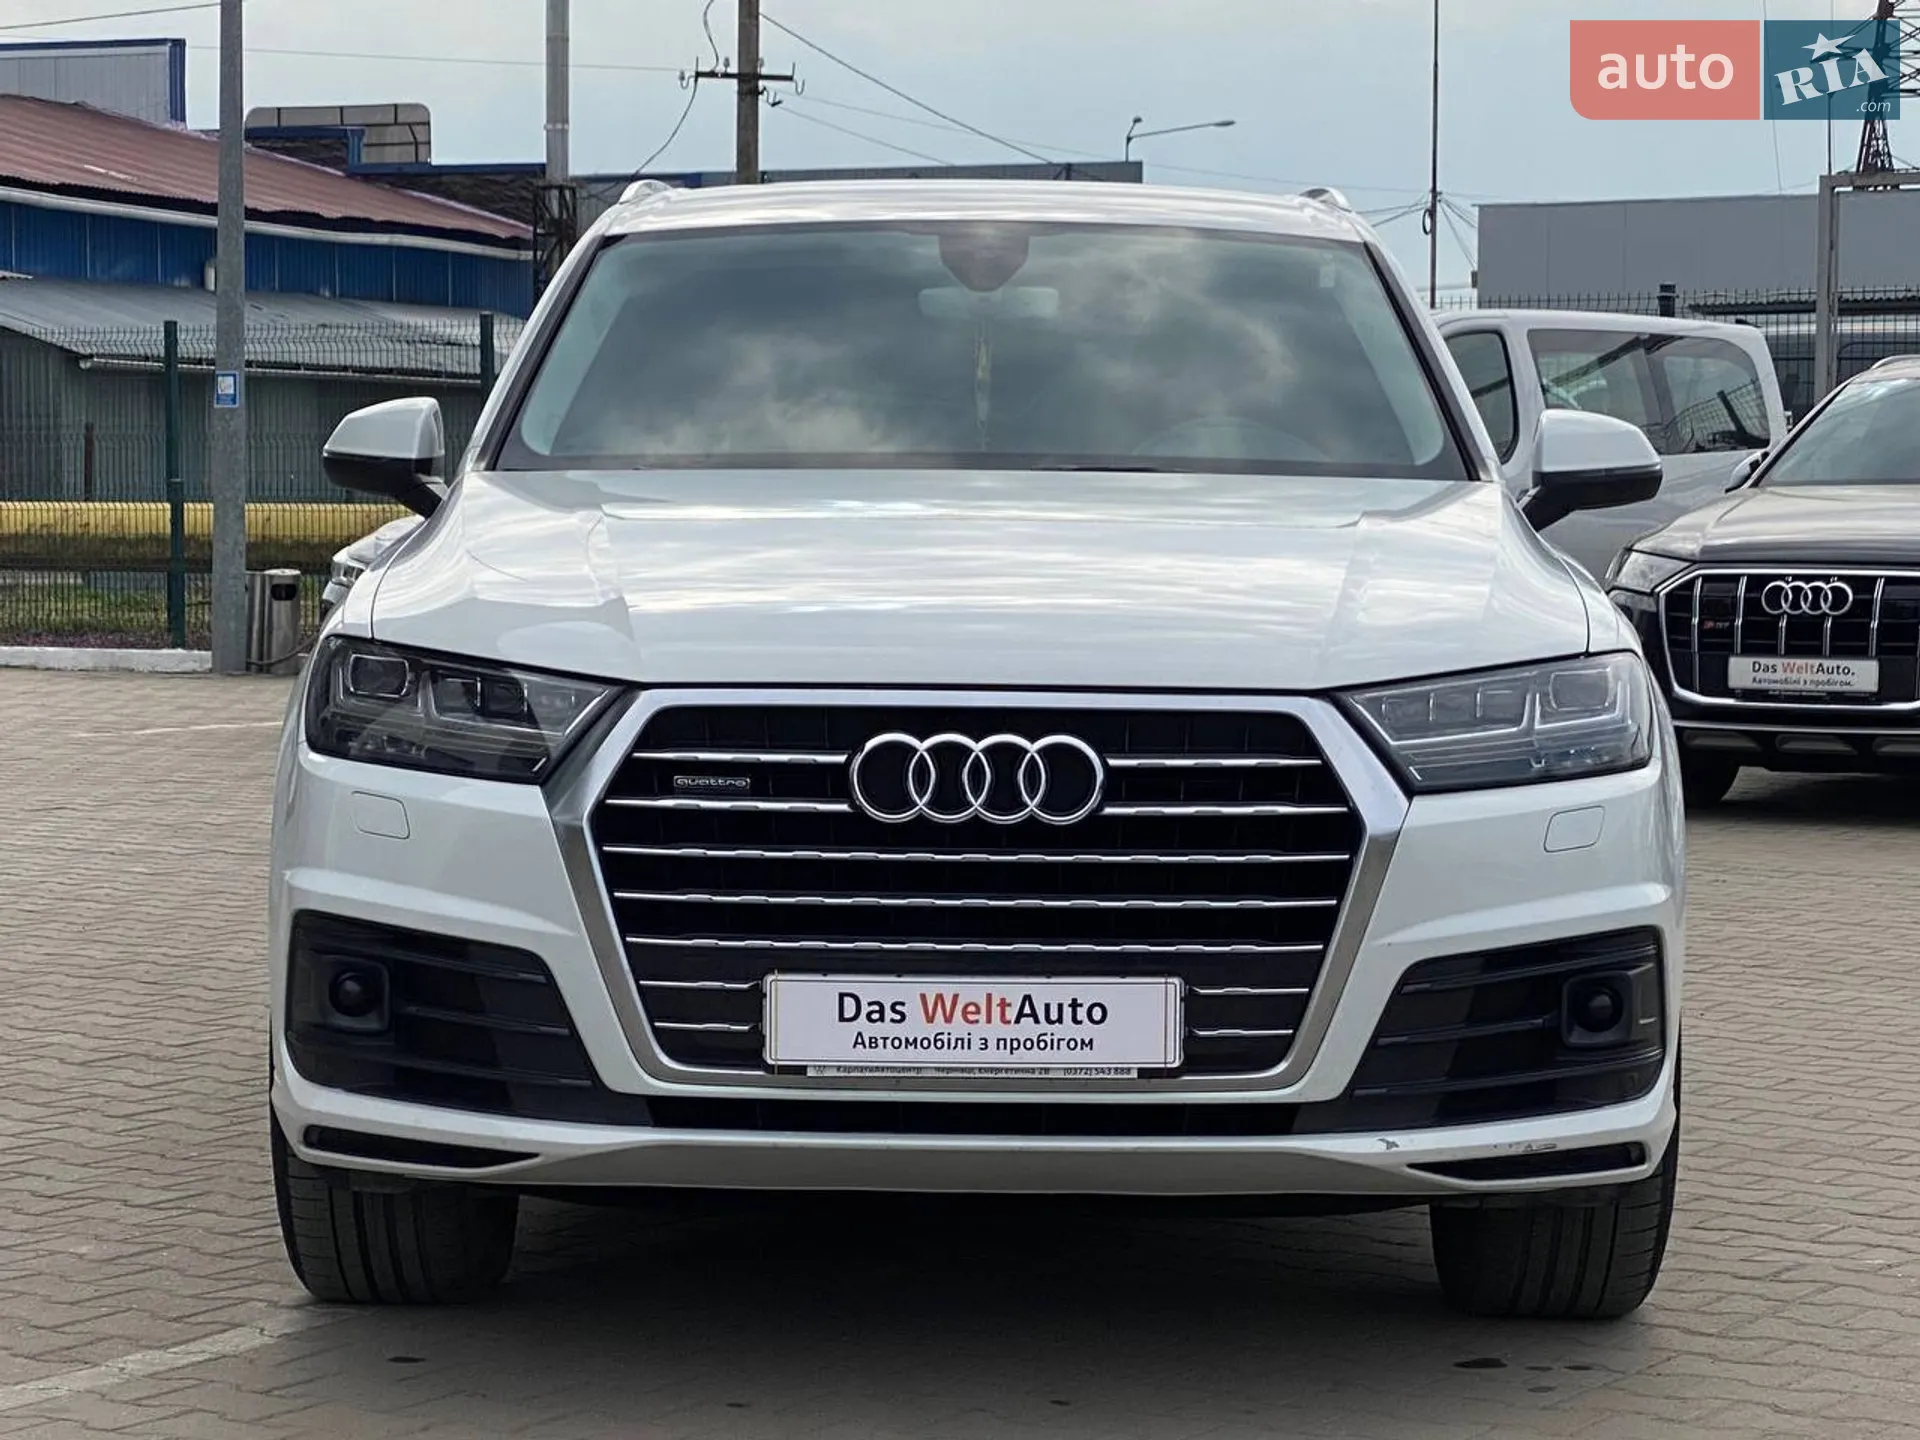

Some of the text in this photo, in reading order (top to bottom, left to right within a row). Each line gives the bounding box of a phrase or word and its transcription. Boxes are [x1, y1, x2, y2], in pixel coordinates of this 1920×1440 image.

[1752, 661, 1856, 676] Das WeltAuto.
[676, 778, 747, 789] quattro
[837, 992, 1108, 1025] Das WeltAuto
[852, 1031, 1094, 1055] Автомобілі з пробігом
